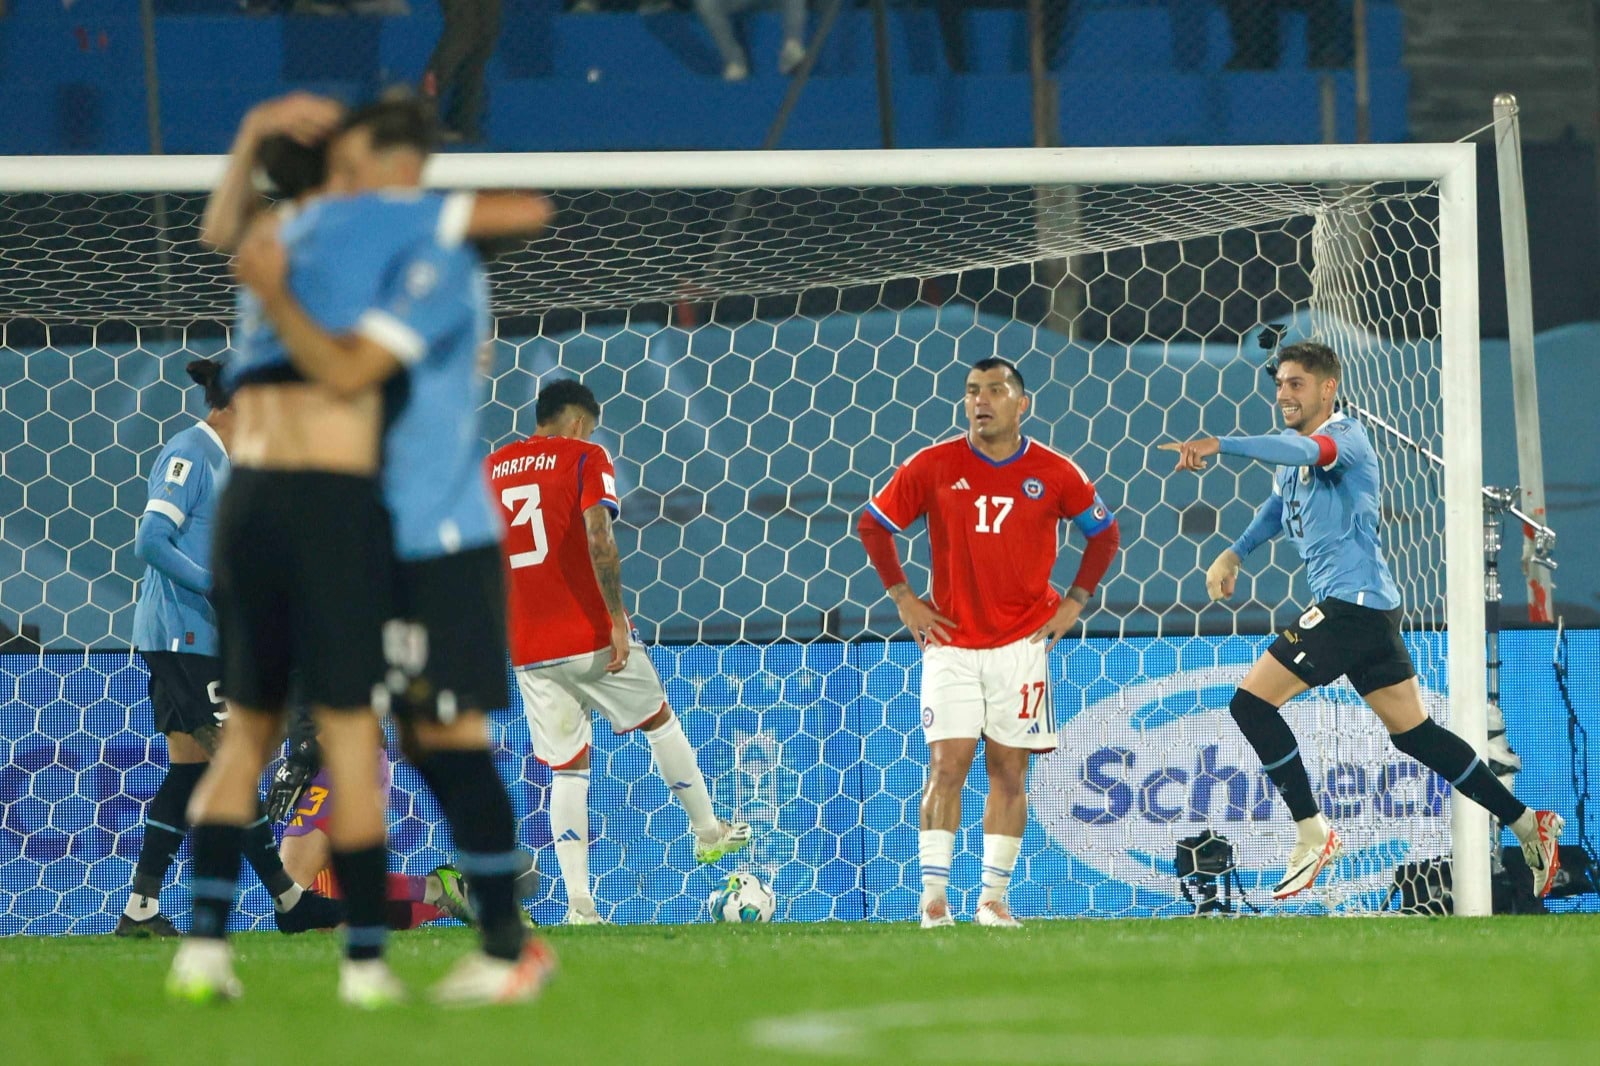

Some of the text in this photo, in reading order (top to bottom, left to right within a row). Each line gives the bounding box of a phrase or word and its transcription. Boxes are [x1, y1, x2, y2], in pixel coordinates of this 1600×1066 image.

[491, 453, 557, 480] MARIPÁN
[501, 483, 549, 570] 3
[974, 495, 1014, 534] 17
[1018, 681, 1045, 719] 17
[1070, 744, 1452, 825] Schec
